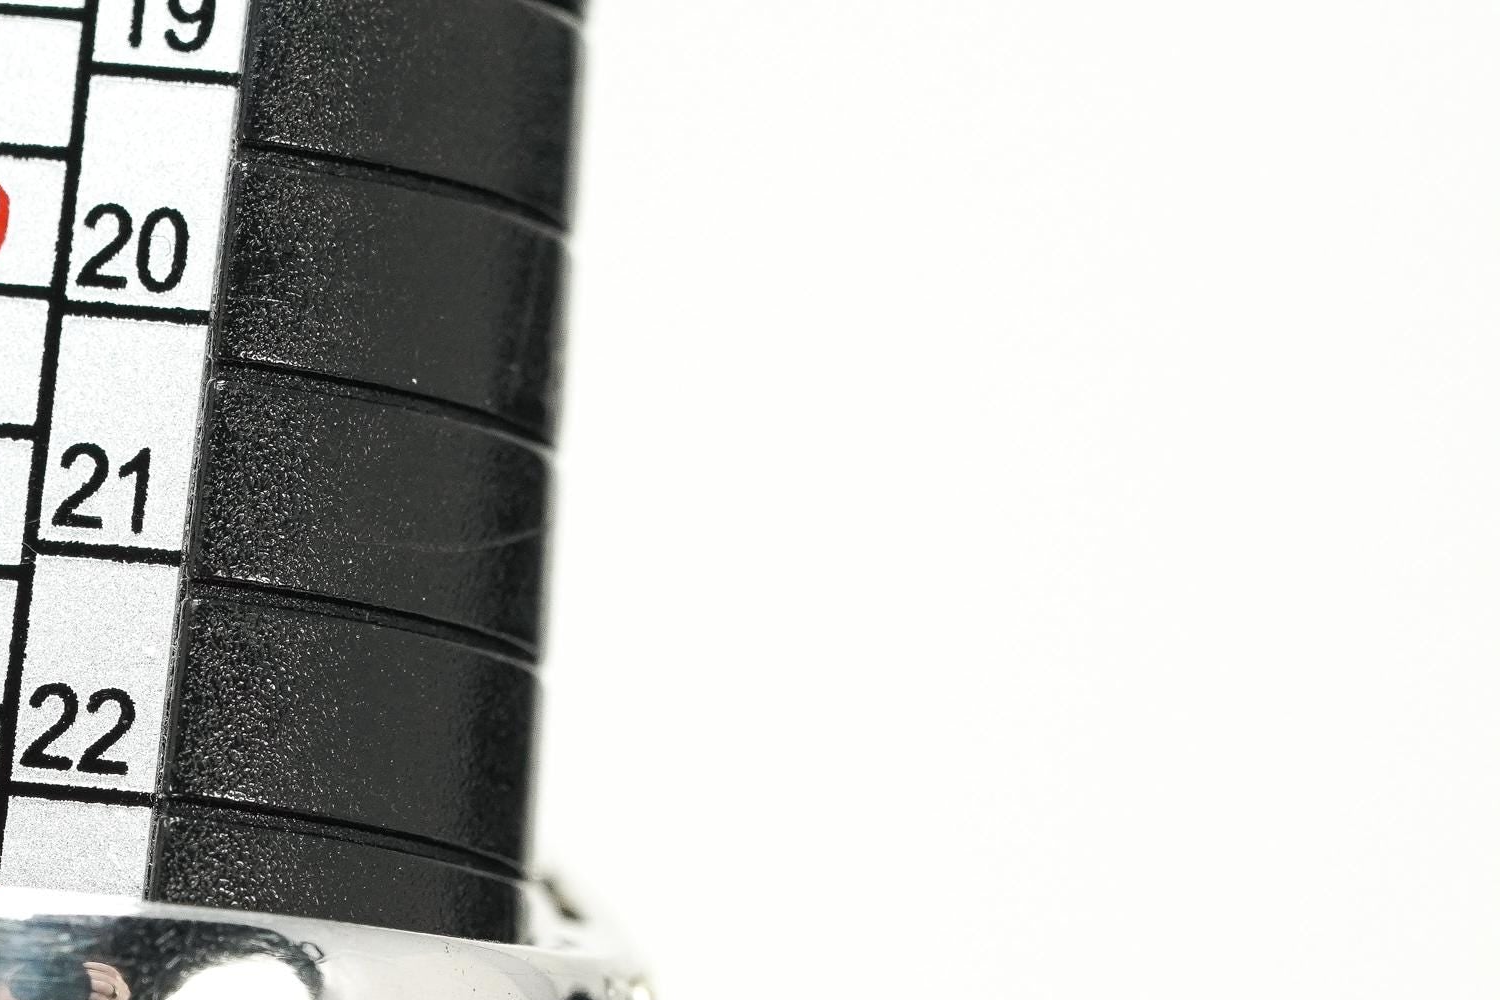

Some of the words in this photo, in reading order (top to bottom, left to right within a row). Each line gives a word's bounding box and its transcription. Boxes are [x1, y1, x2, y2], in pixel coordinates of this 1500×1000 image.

[75, 202, 190, 294] 20
[51, 442, 151, 535] 21
[19, 682, 136, 776] 22
